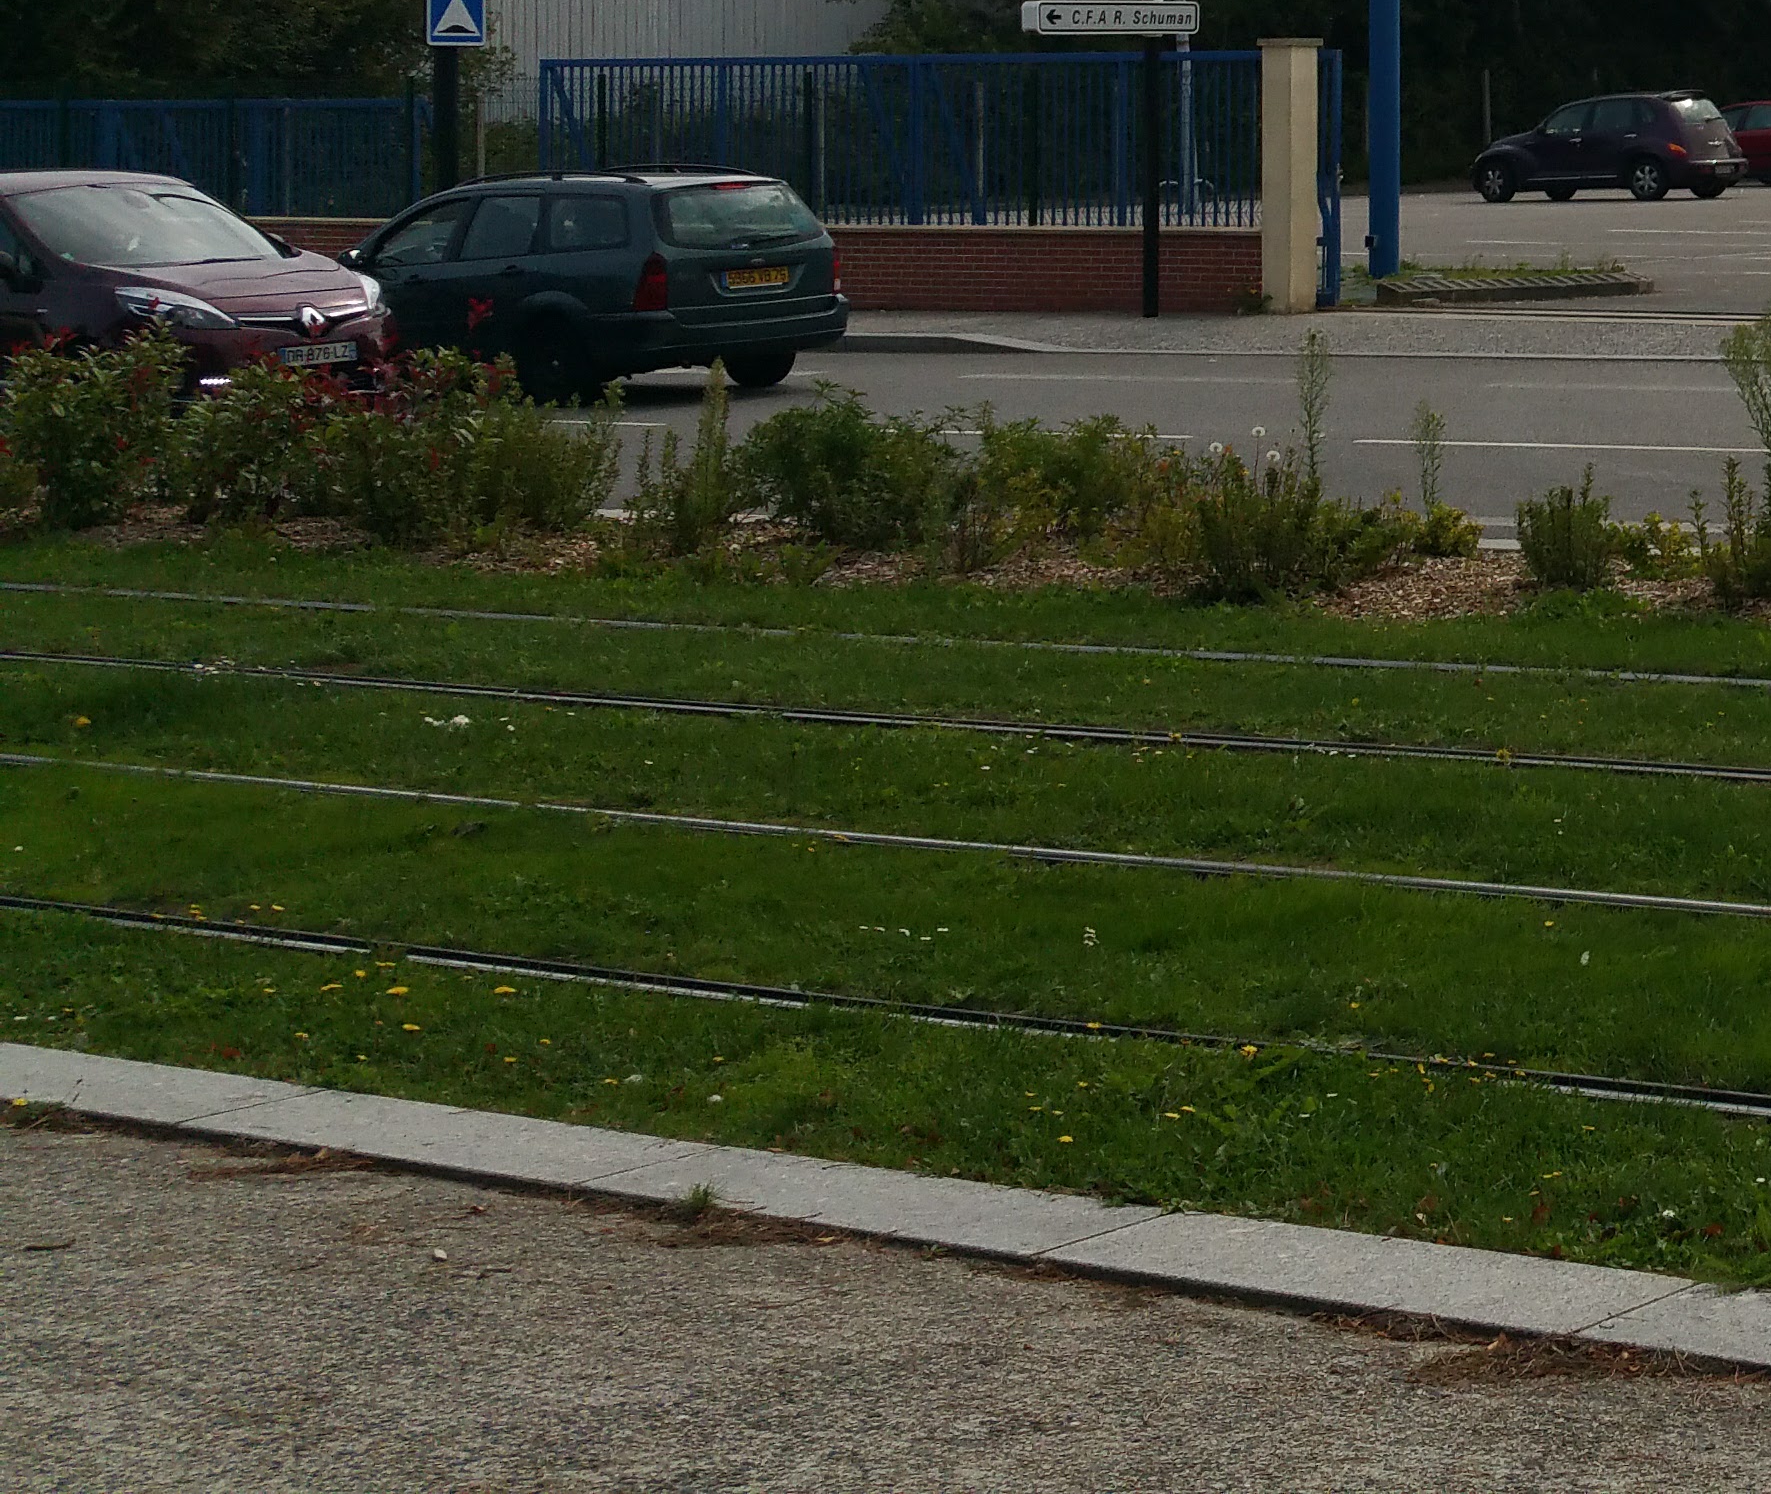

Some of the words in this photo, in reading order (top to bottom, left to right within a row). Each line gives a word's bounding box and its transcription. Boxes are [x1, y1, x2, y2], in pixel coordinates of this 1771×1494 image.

[1072, 10, 1106, 25] C.F.A
[1113, 10, 1126, 25] R.
[1132, 10, 1192, 25] Schuman
